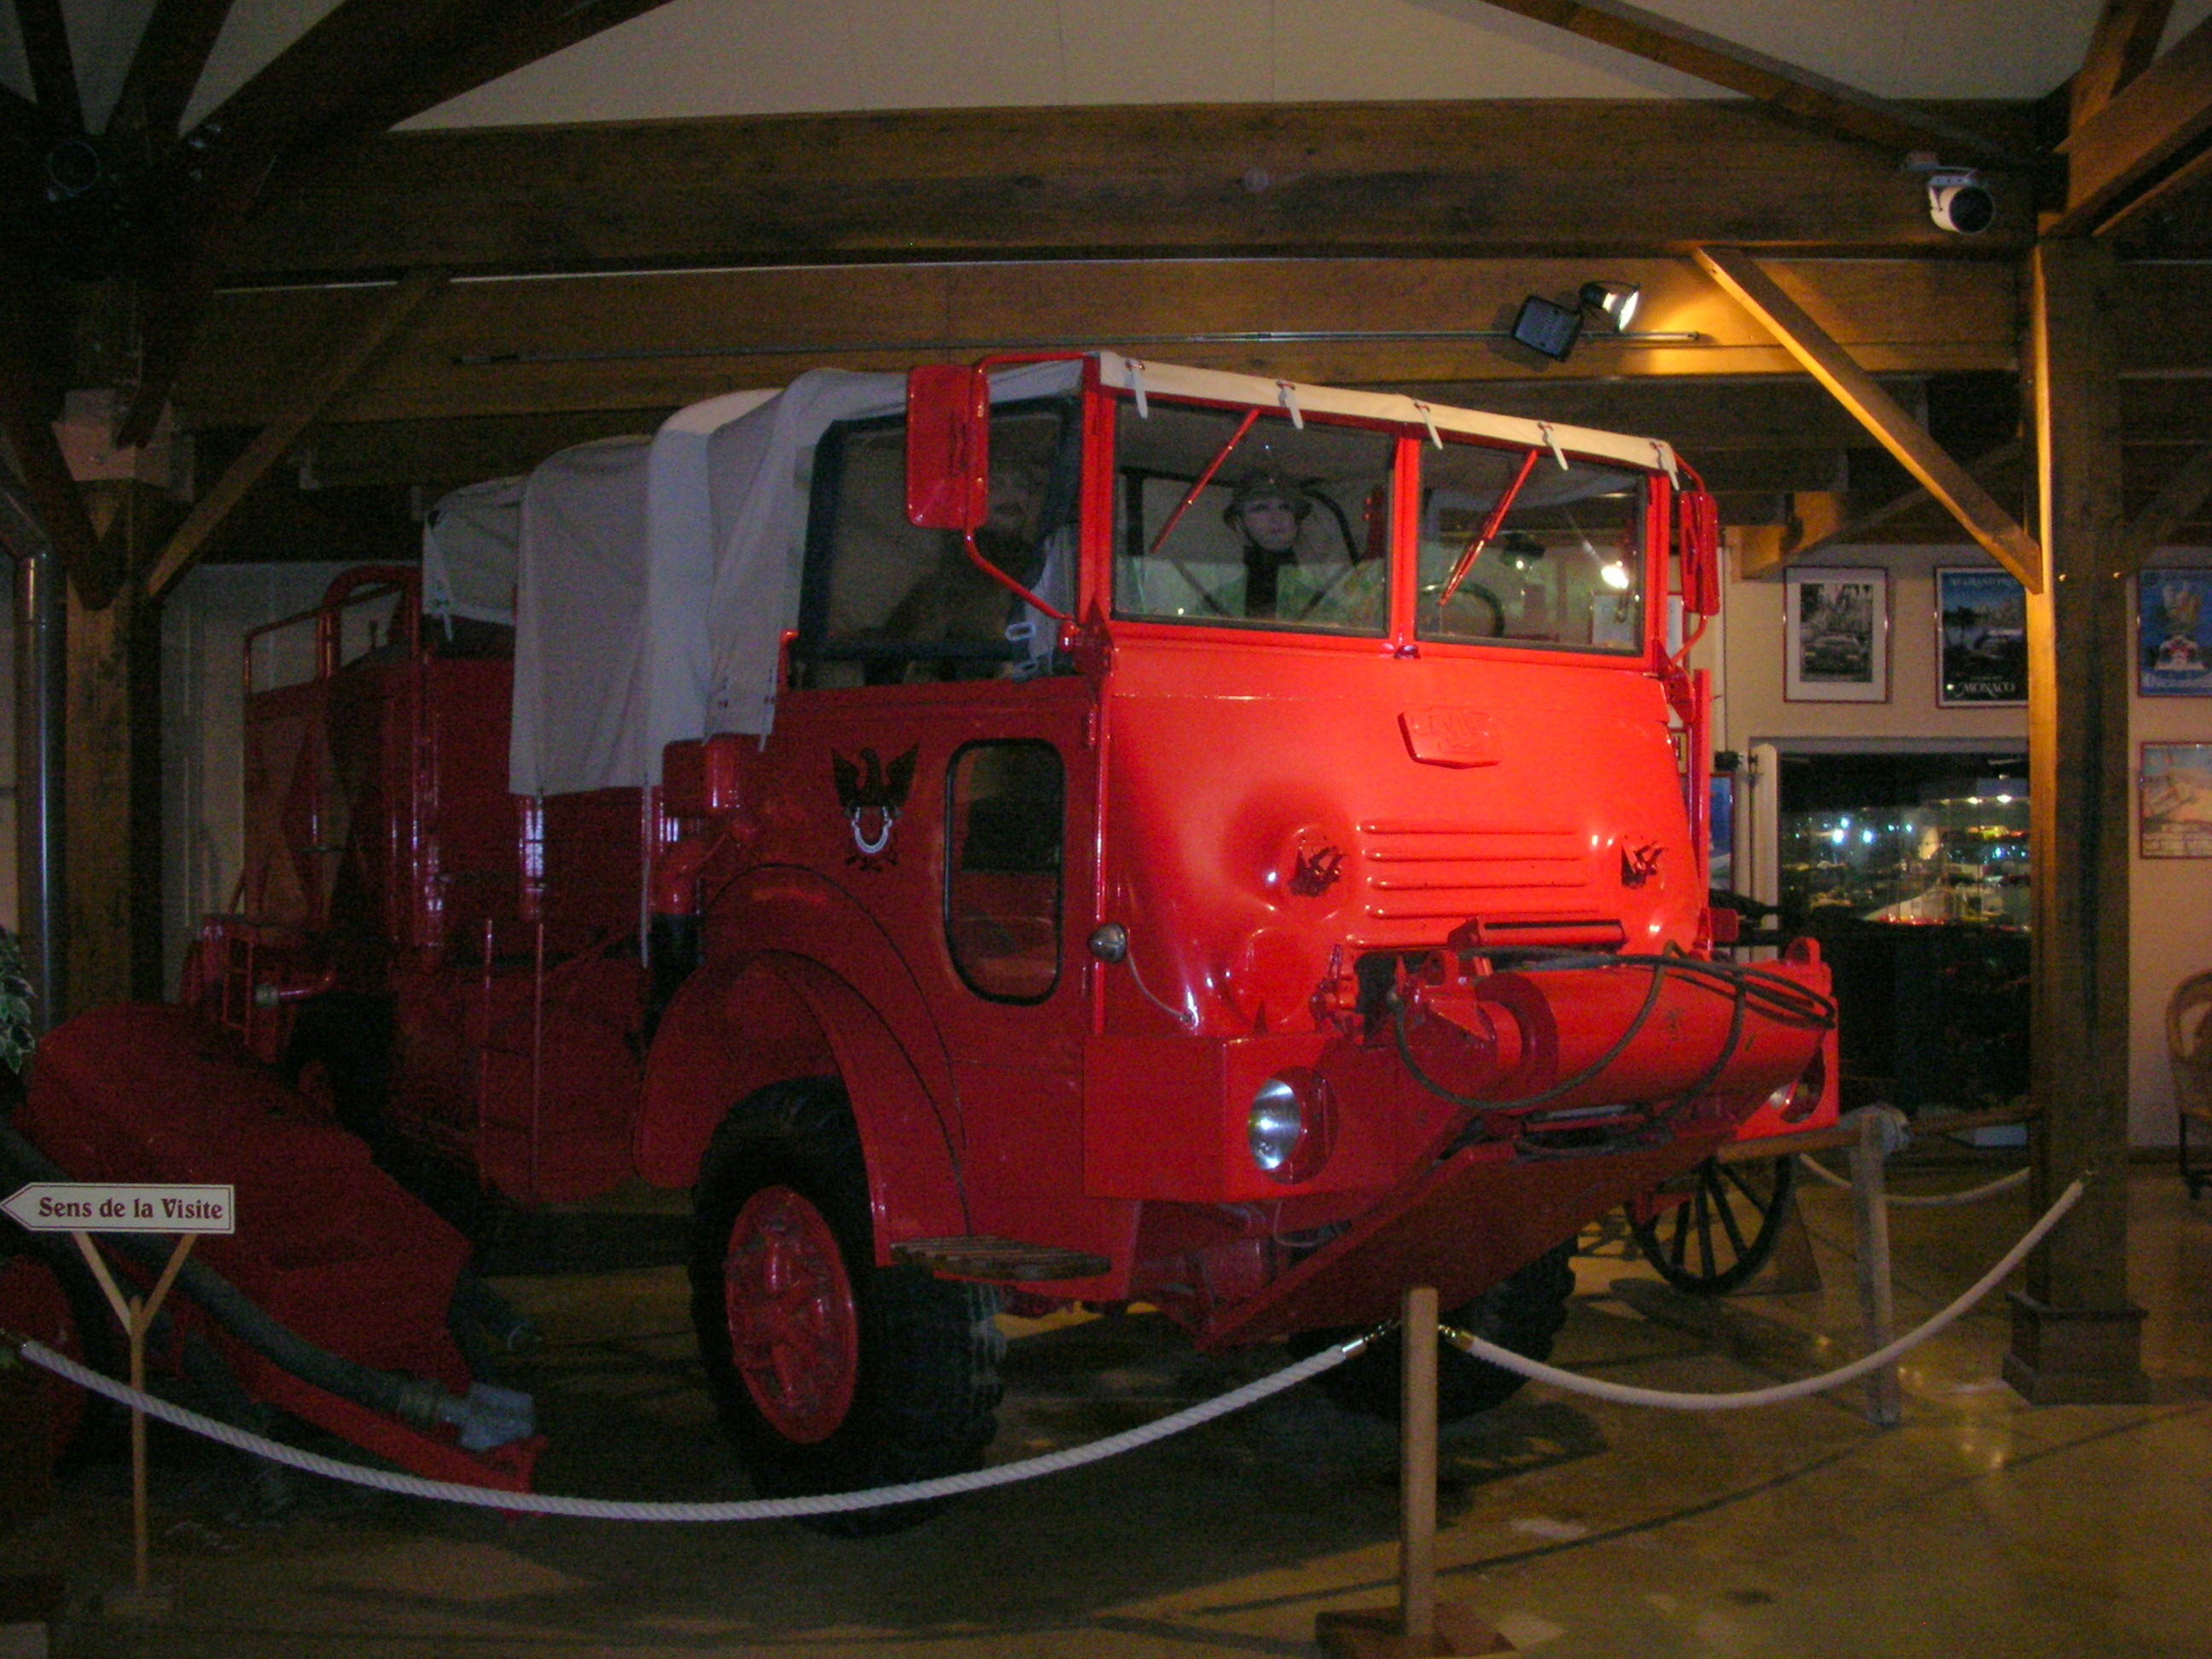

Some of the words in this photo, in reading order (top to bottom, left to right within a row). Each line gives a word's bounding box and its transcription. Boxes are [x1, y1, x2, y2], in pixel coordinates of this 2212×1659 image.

[1956, 682, 2016, 697] MONACO
[38, 1196, 92, 1218] Sens
[99, 1198, 126, 1218] de
[133, 1198, 154, 1219] la
[161, 1198, 223, 1219] Visite
